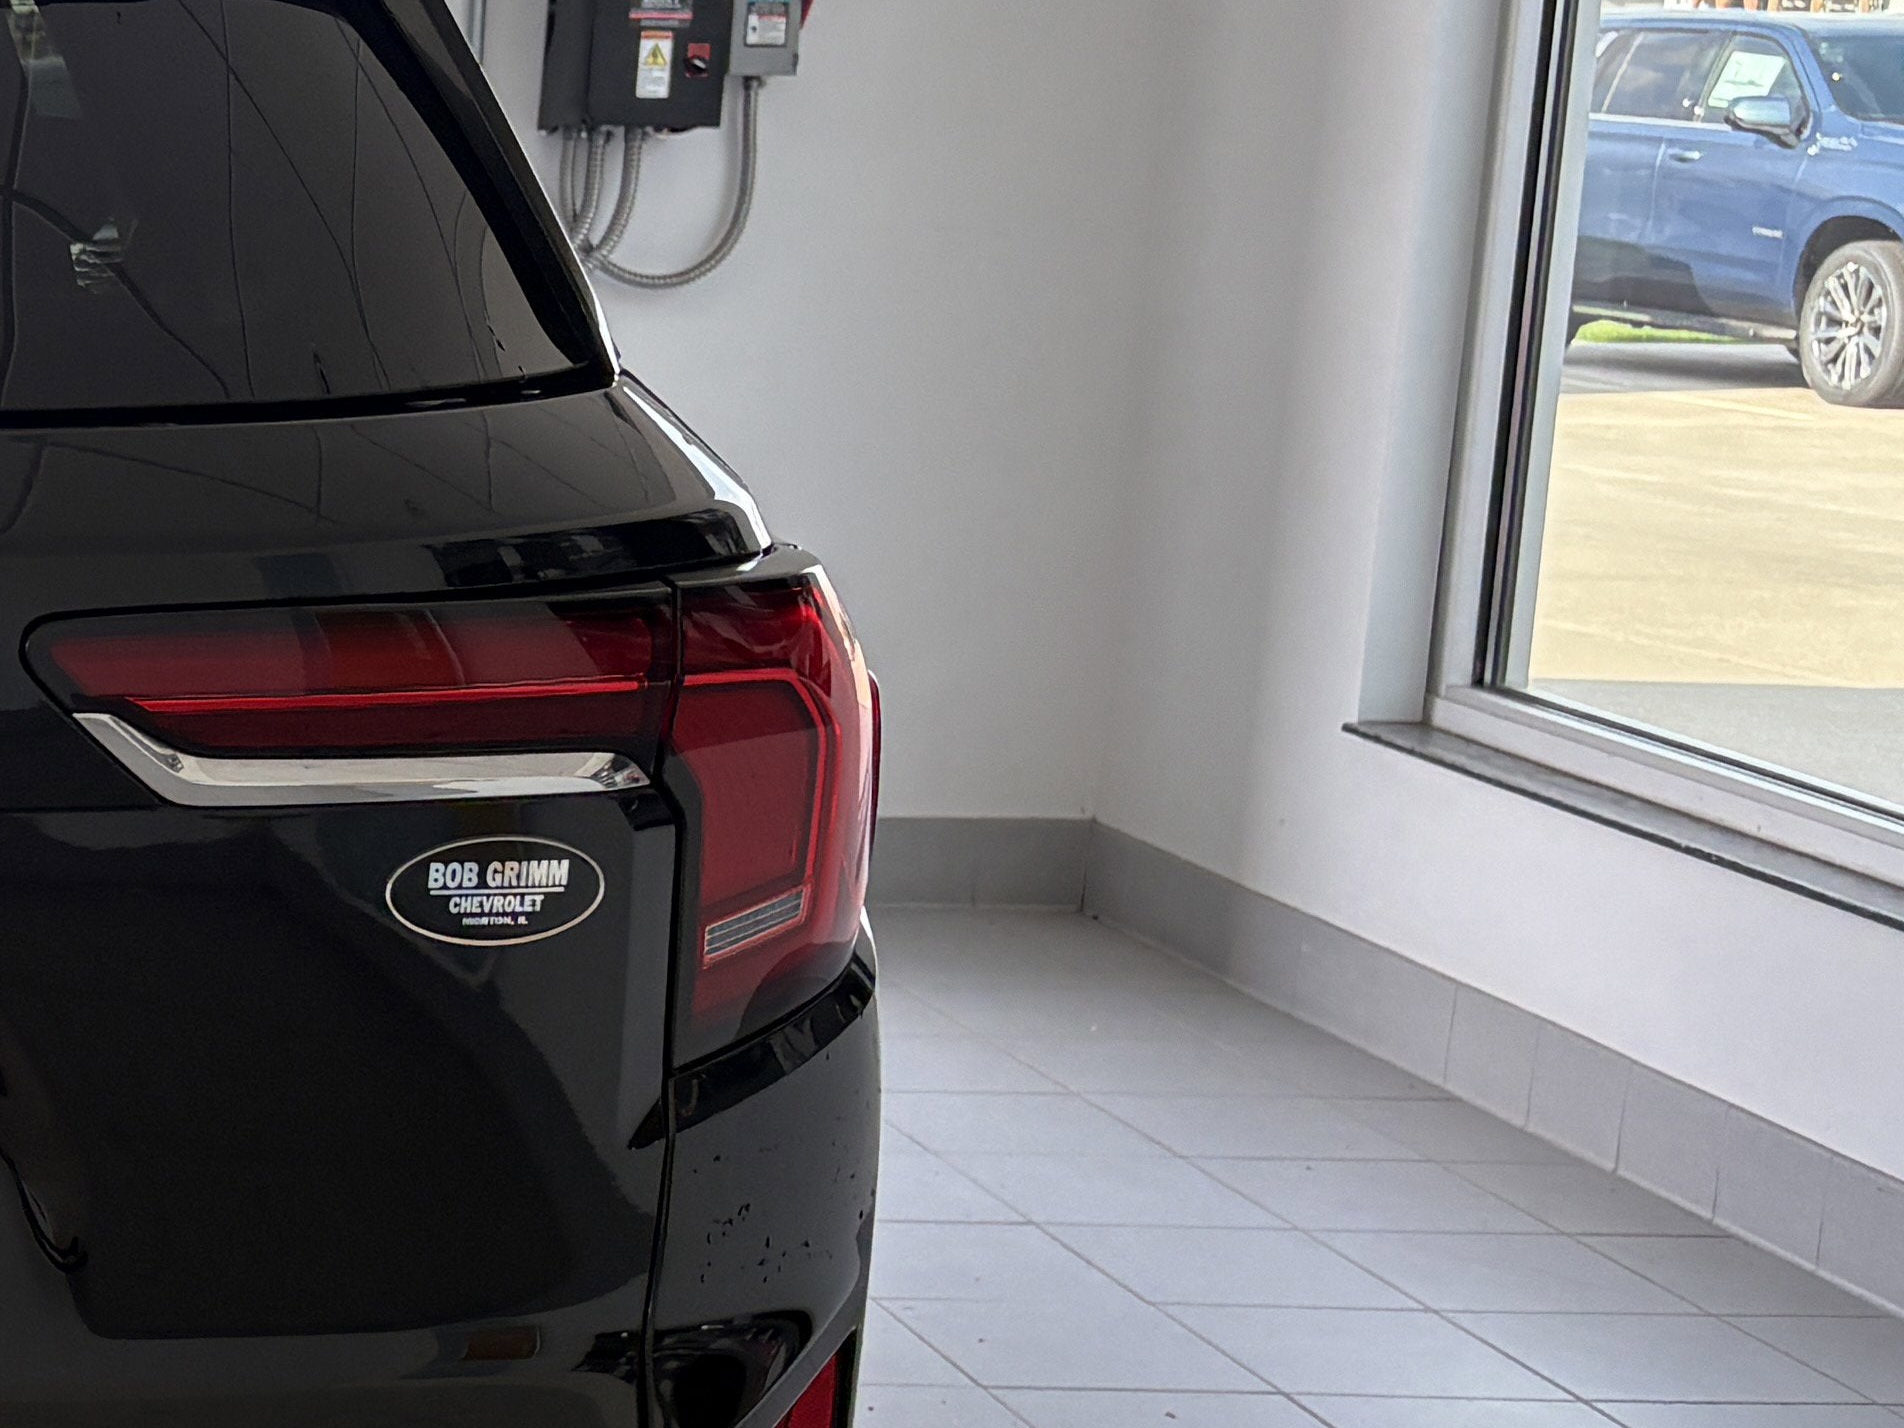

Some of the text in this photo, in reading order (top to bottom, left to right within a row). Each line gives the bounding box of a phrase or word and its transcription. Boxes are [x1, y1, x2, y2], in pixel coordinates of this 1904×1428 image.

[427, 858, 570, 889] BOB GRIMM
[448, 894, 545, 914] CHEVROLET
